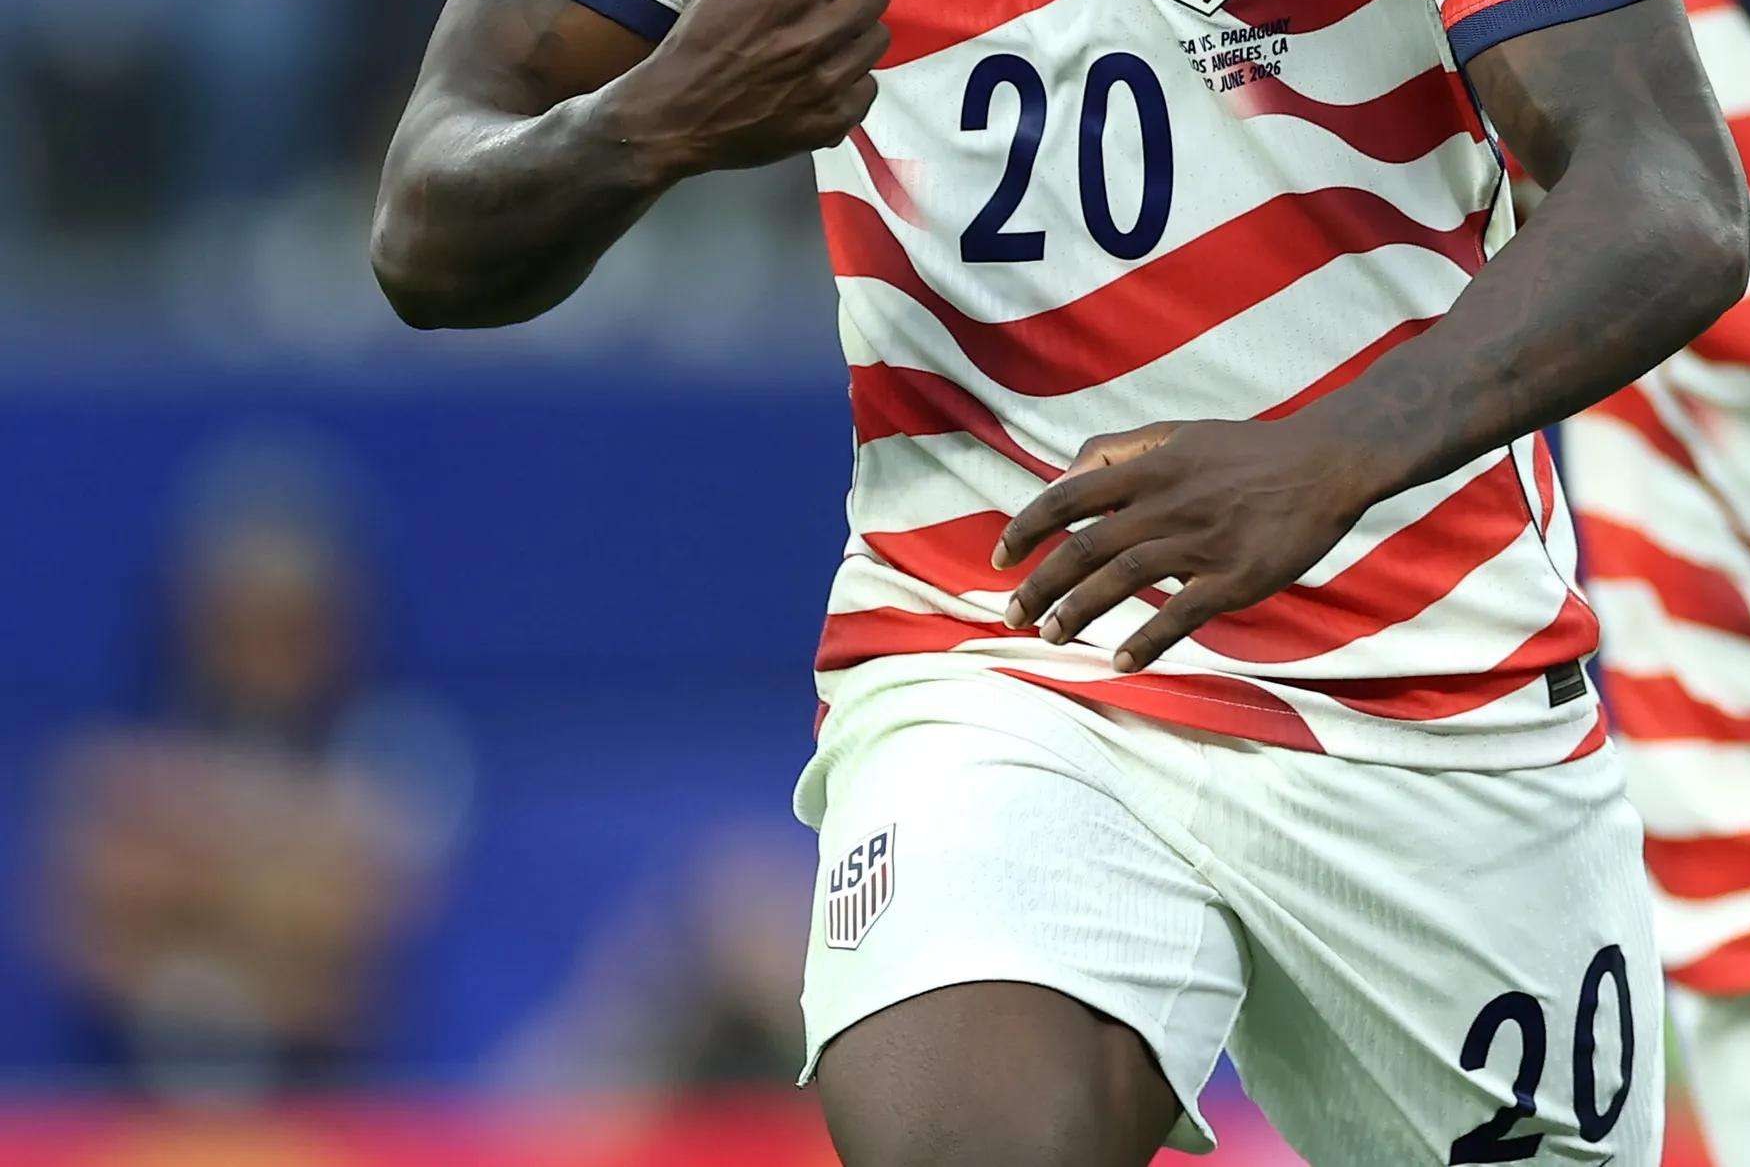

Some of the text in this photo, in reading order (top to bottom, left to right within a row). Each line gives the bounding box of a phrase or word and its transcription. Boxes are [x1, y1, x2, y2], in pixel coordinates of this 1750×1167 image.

[1179, 17, 1290, 54] SA VS. PARAGUAY
[1272, 37, 1288, 55] CA
[1220, 68, 1245, 93] JUNE
[1250, 60, 1281, 82] 2026
[960, 51, 1174, 263] 20
[830, 833, 888, 893] USA
[1448, 943, 1635, 1166] 20
